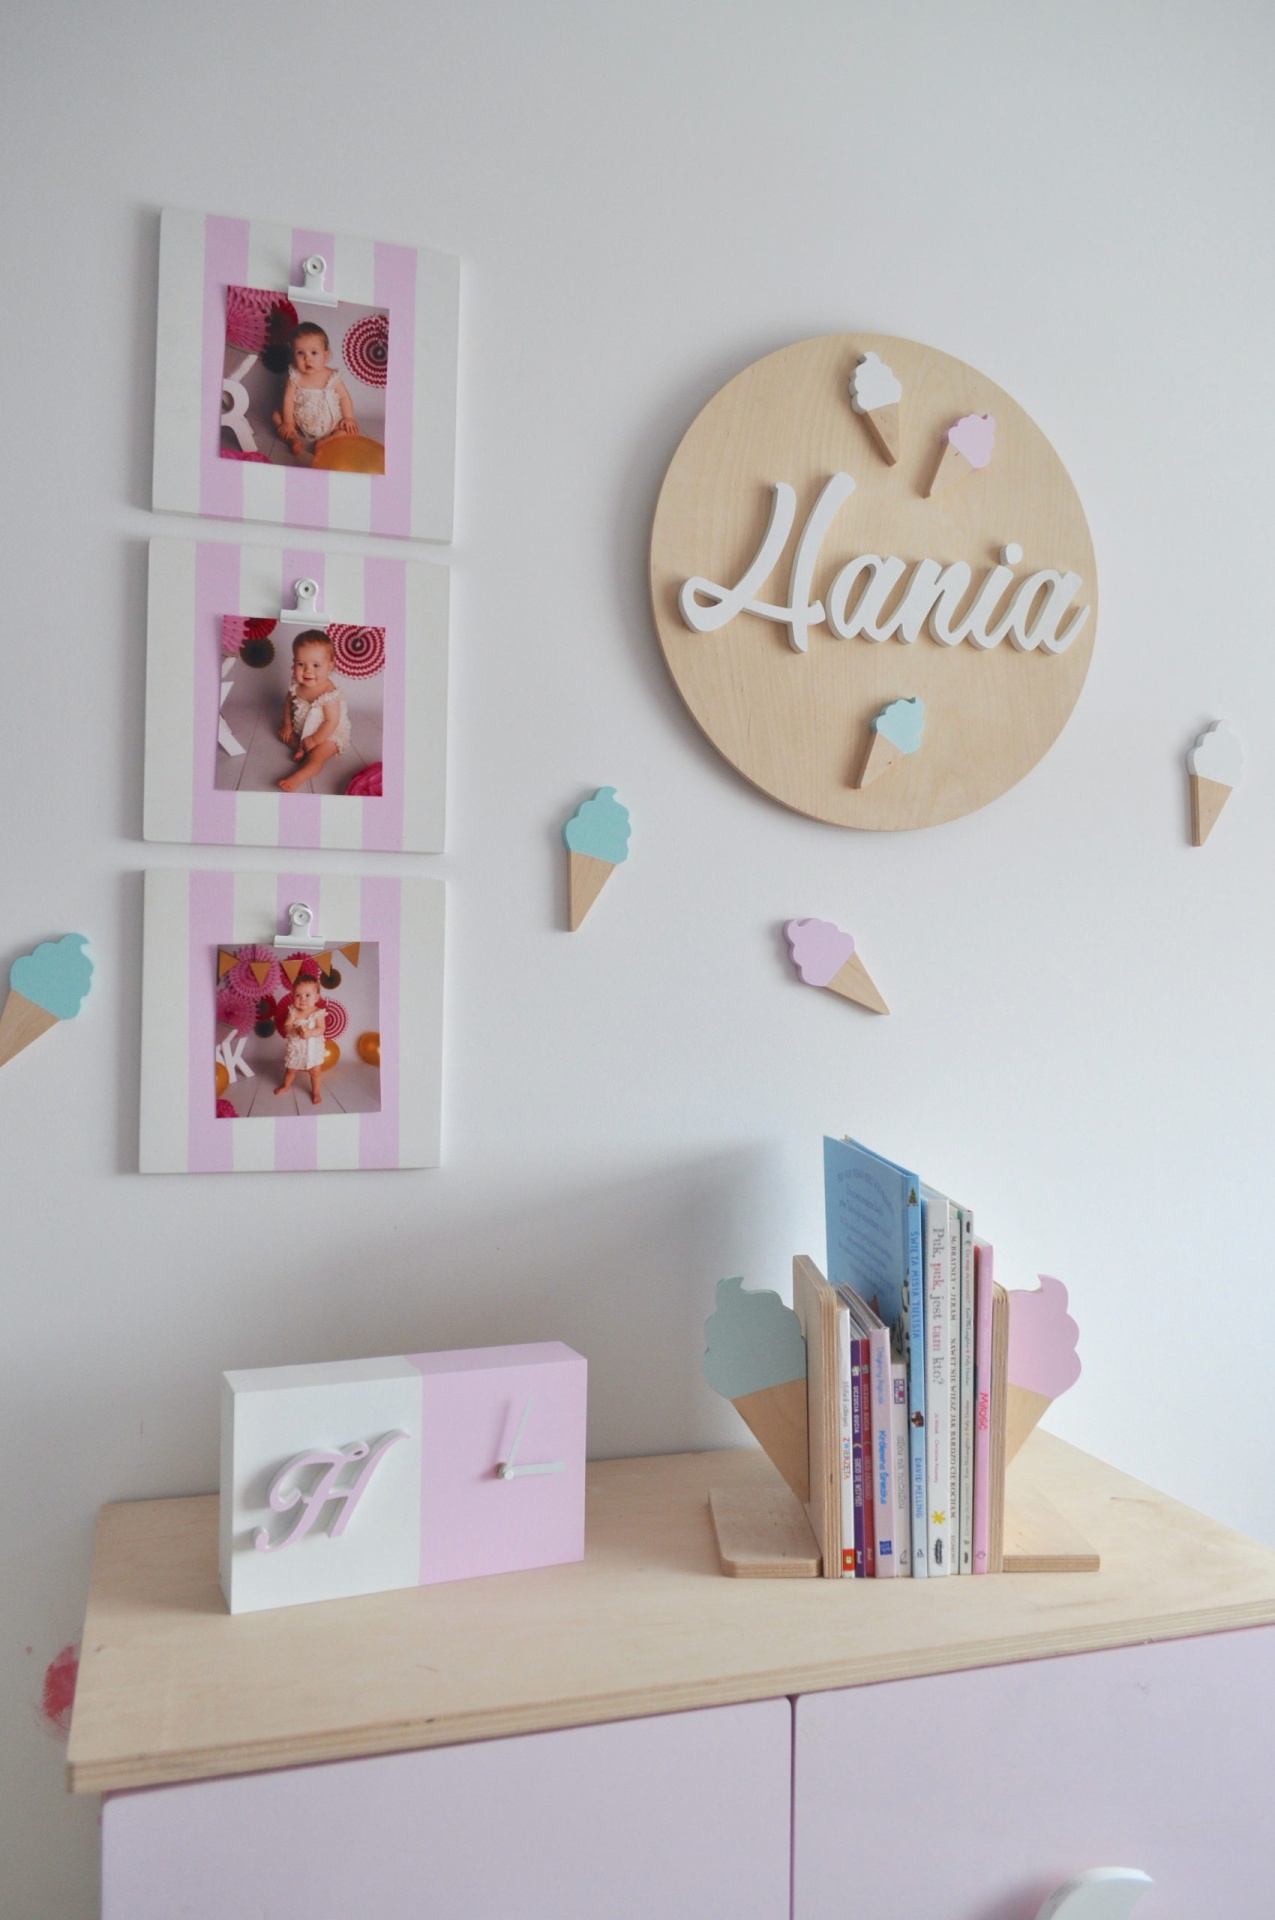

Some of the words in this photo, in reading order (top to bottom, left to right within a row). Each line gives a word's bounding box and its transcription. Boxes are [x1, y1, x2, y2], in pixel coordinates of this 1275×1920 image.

[678, 471, 1091, 655] Hania
[909, 1231, 920, 1266] ŚWIĘTA
[911, 1270, 919, 1297] MISIA
[930, 1294, 944, 1320] jest
[932, 1325, 944, 1352] tam
[932, 1356, 945, 1385] kto?
[978, 1392, 990, 1431] Miłość
[914, 1457, 923, 1483] DAVID
[915, 1484, 924, 1519] MELLING
